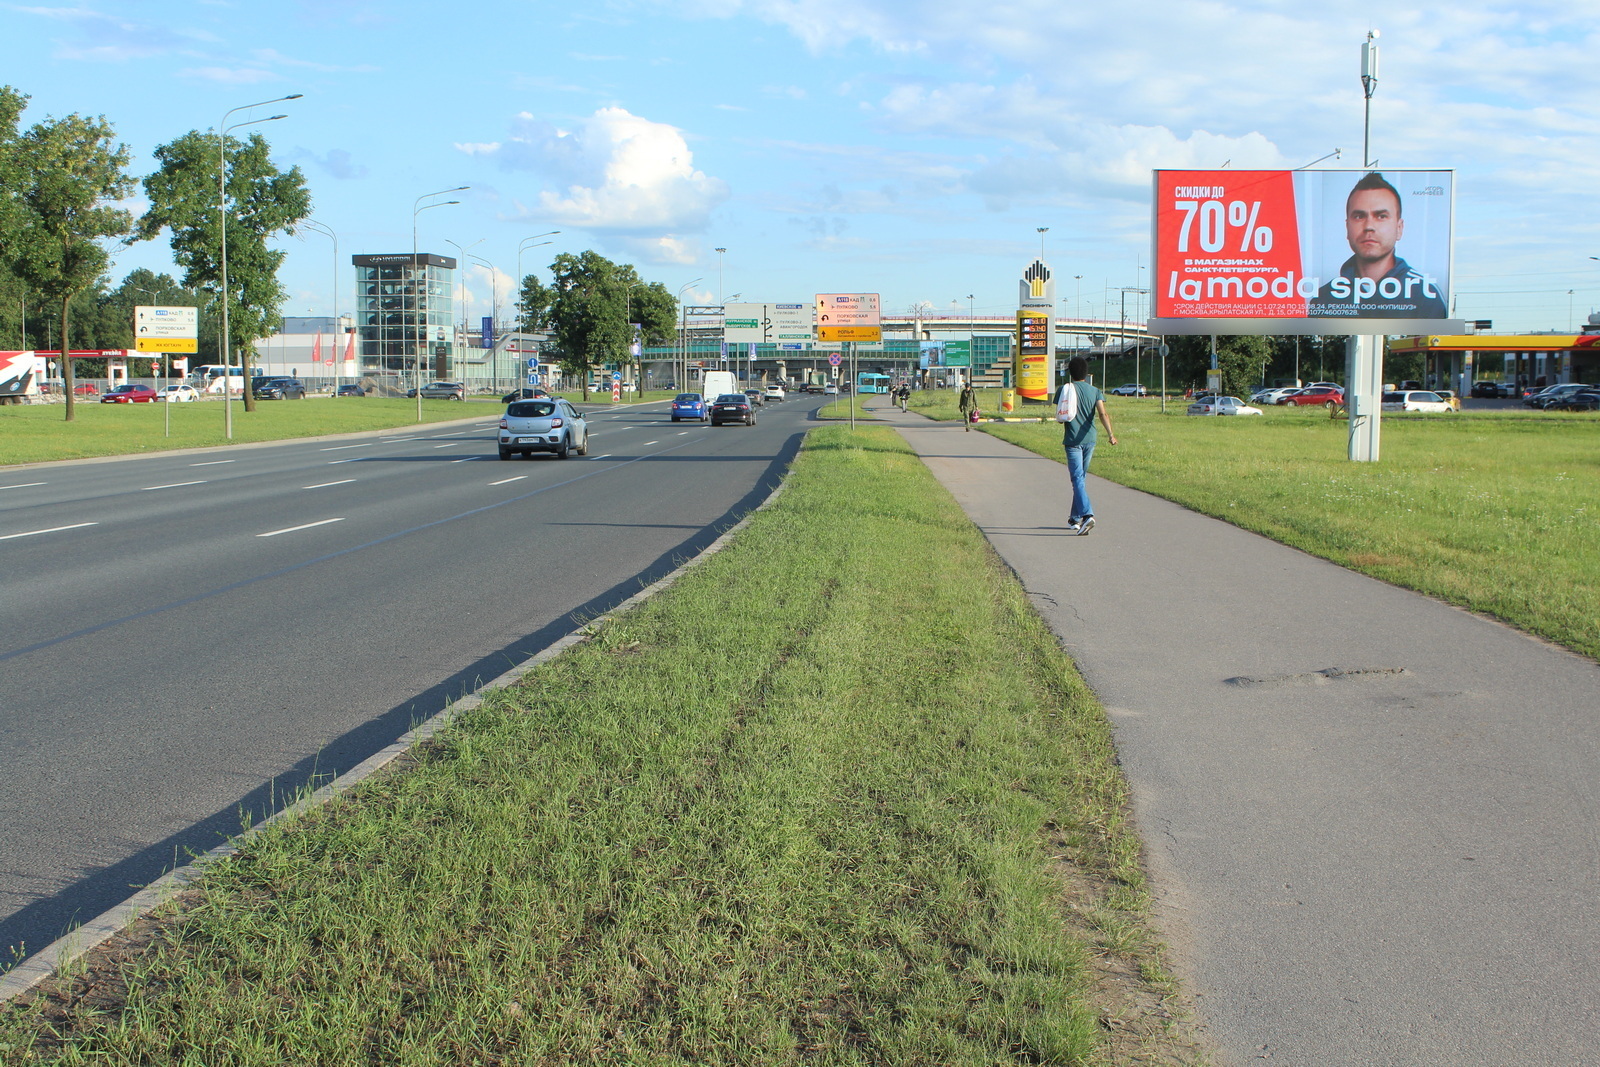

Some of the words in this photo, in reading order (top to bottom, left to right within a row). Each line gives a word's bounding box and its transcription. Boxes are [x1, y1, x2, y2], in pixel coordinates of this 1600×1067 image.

[1175, 186, 1210, 199] СКИДКИ
[1211, 186, 1225, 199] ДО
[1175, 200, 1273, 253] 70%
[1168, 270, 1319, 301] lamoda
[1330, 274, 1437, 303] sport
[1195, 302, 1232, 310] ДЕЙСТВИЯ
